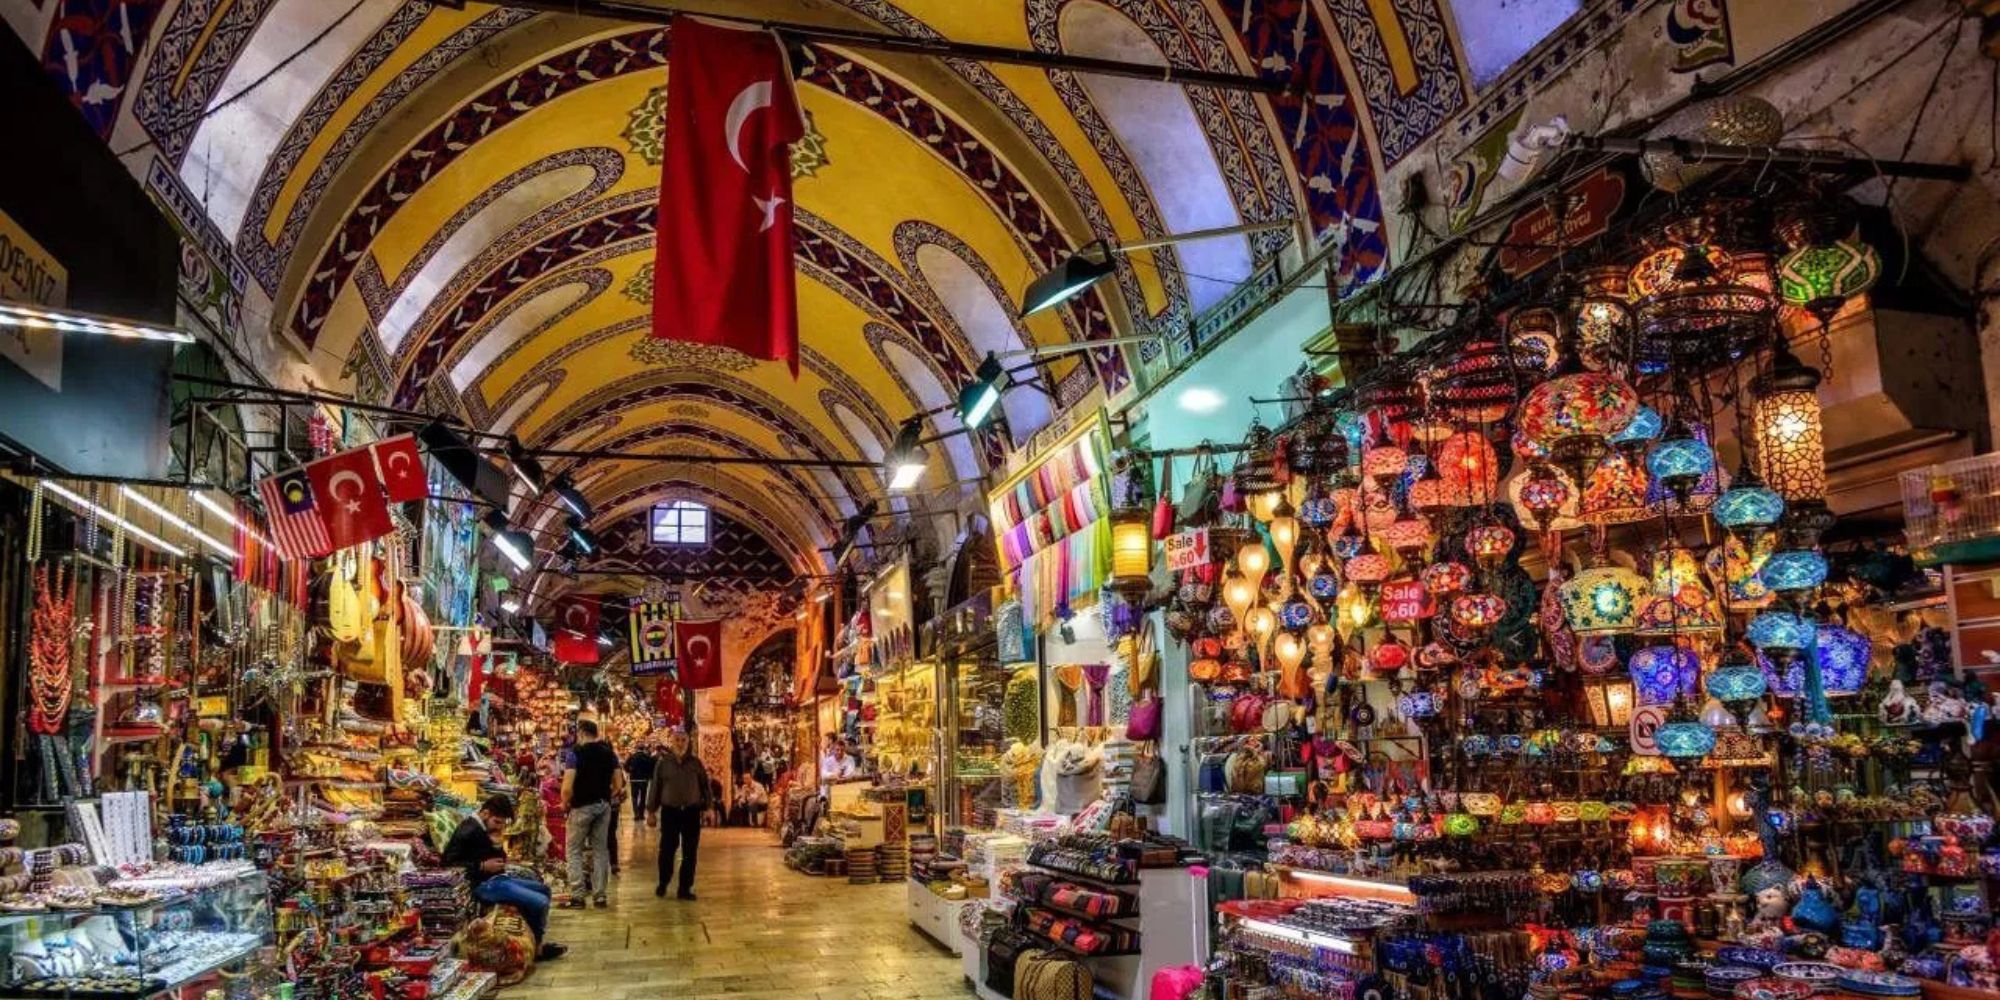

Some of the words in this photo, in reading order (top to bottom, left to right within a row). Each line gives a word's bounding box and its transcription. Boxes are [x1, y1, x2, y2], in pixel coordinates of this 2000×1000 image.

[1168, 535, 1193, 551] Sale
[1168, 550, 1194, 568] %60
[1382, 584, 1419, 601] Sale
[1382, 601, 1420, 620] %60
